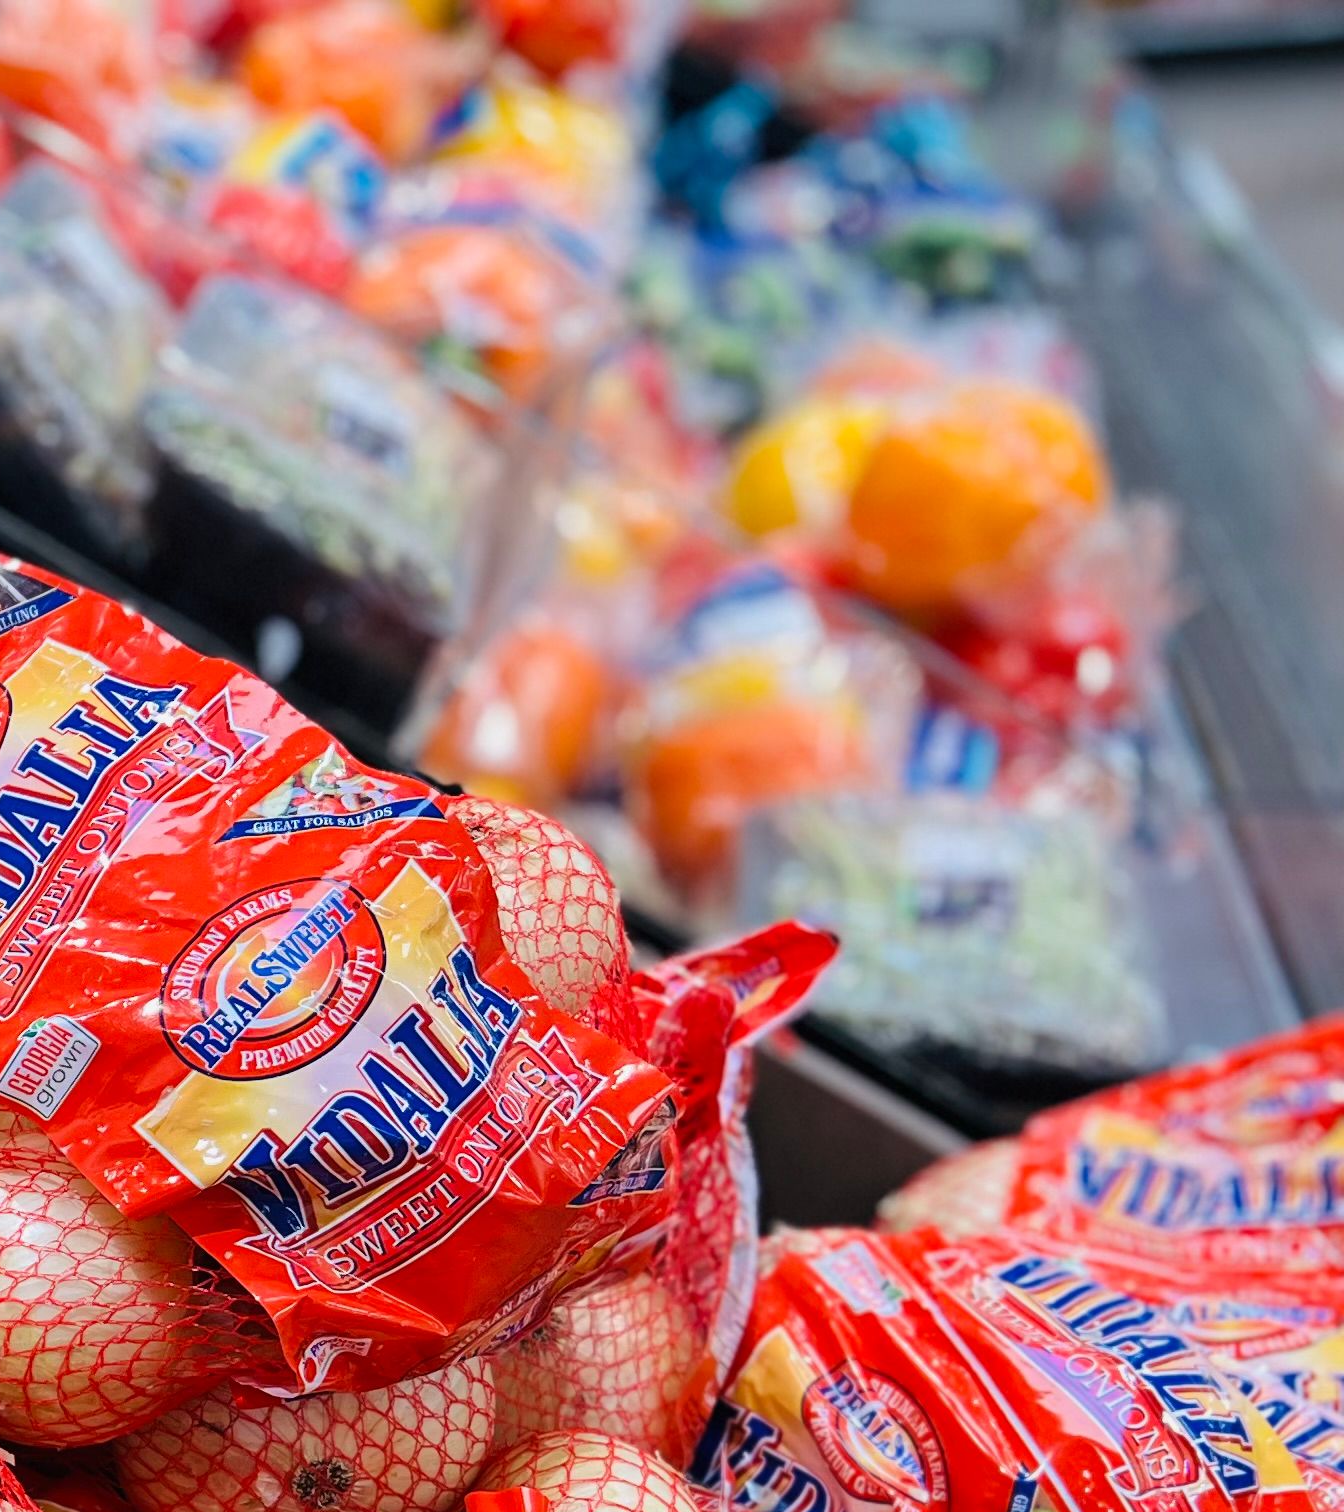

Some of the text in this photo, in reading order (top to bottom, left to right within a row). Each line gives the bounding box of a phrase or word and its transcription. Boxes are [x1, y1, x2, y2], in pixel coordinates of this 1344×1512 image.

[76, 732, 198, 856] ONIONS
[251, 804, 395, 836] GREAT FOR SALADS
[170, 888, 295, 1003] SHUMAN FARMS
[180, 886, 357, 1070] REALSWEET
[8, 1020, 73, 1097] GEORGIA
[238, 946, 379, 1072] PREMIUM QUALITY
[35, 1039, 99, 1109] grown
[224, 942, 524, 1241] VIDALIA
[323, 1056, 550, 1282] SWEET ONIONS
[1074, 1143, 1344, 1228] VIDALI
[921, 1436, 948, 1502] FARMS
[1064, 1350, 1183, 1482] ONIONS
